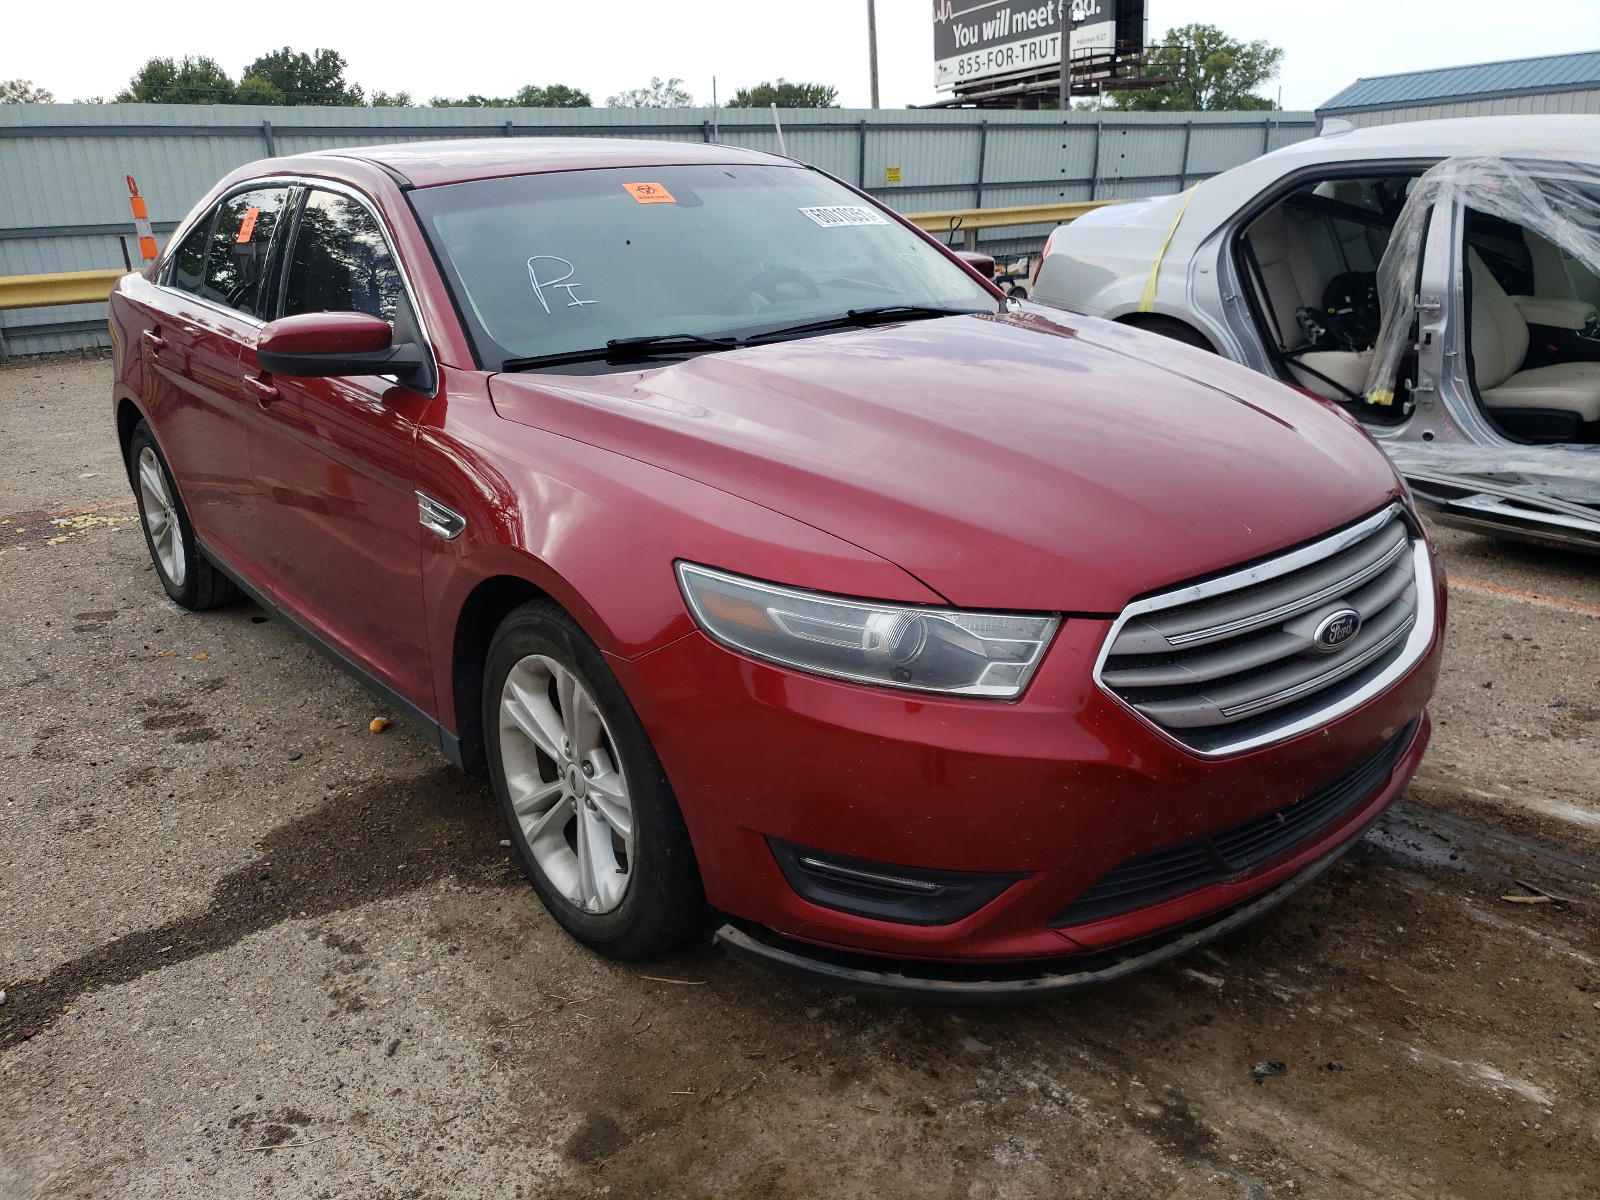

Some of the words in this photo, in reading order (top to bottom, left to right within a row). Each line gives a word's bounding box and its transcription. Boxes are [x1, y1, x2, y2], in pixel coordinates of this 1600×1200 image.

[952, 23, 979, 49] You
[982, 8, 1011, 42] will
[1012, 0, 1055, 34] meet
[1057, 0, 1101, 19] od.
[958, 36, 1060, 76] 855-FOR-TRUT
[1329, 618, 1353, 643] Ford
